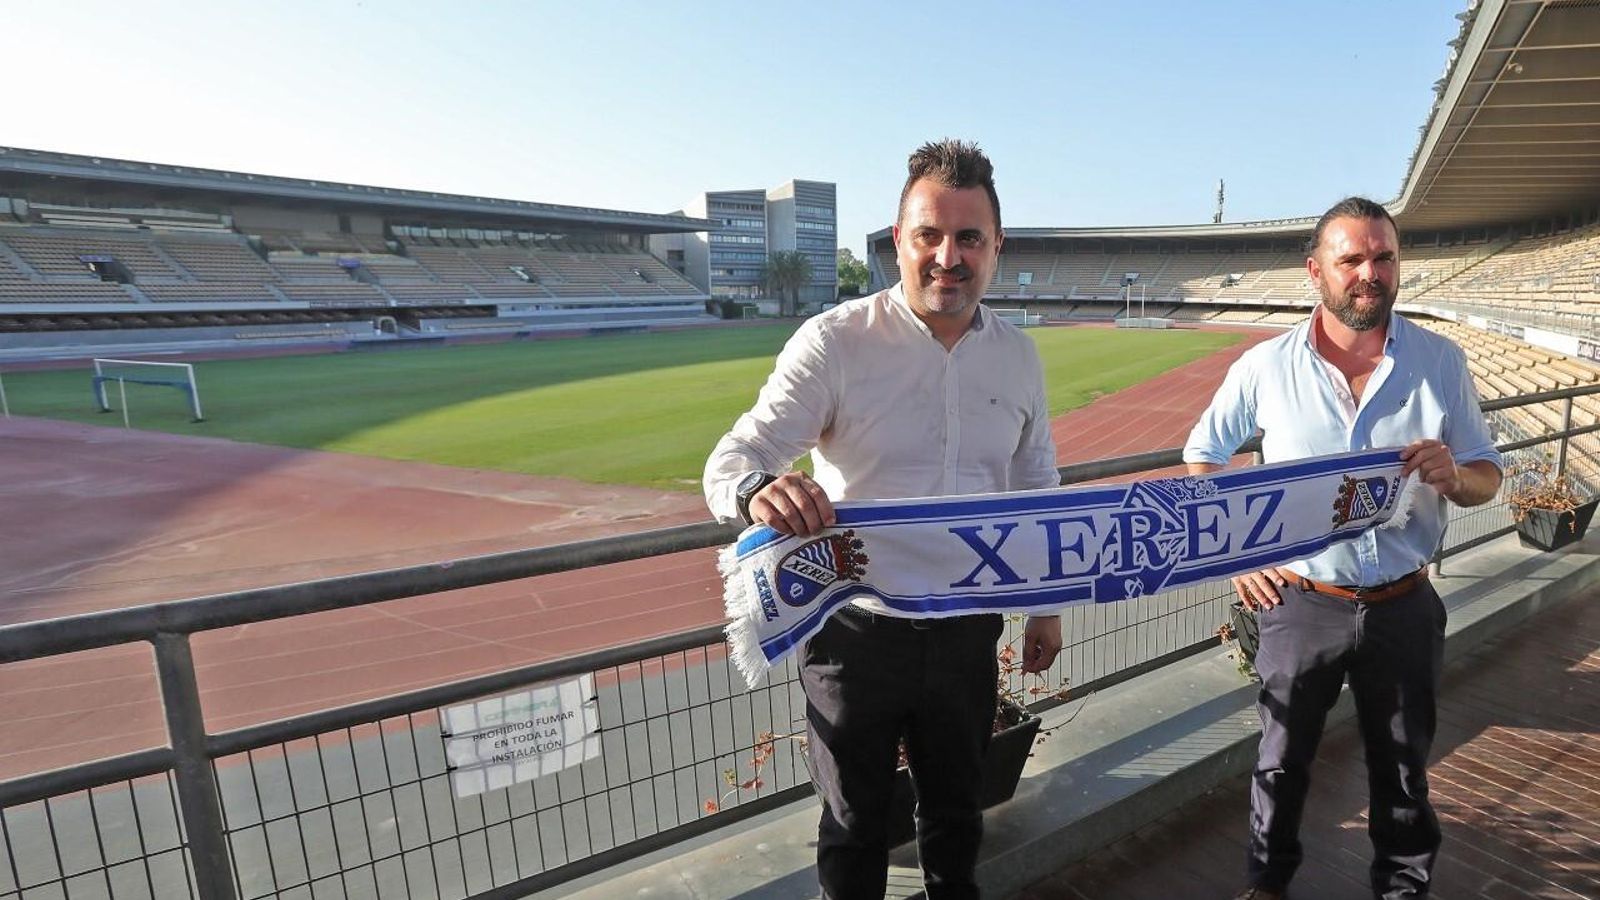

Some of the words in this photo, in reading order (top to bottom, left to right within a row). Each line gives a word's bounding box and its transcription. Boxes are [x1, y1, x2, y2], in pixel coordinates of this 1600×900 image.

[948, 488, 1285, 589] XEREZ
[785, 559, 835, 584] XEREZ
[753, 567, 780, 622] XEREZ
[472, 720, 534, 742] PROHIBIDO
[535, 711, 574, 726] FUMAR
[494, 739, 509, 749] EN
[512, 731, 542, 744] TODA
[544, 728, 558, 738] LA
